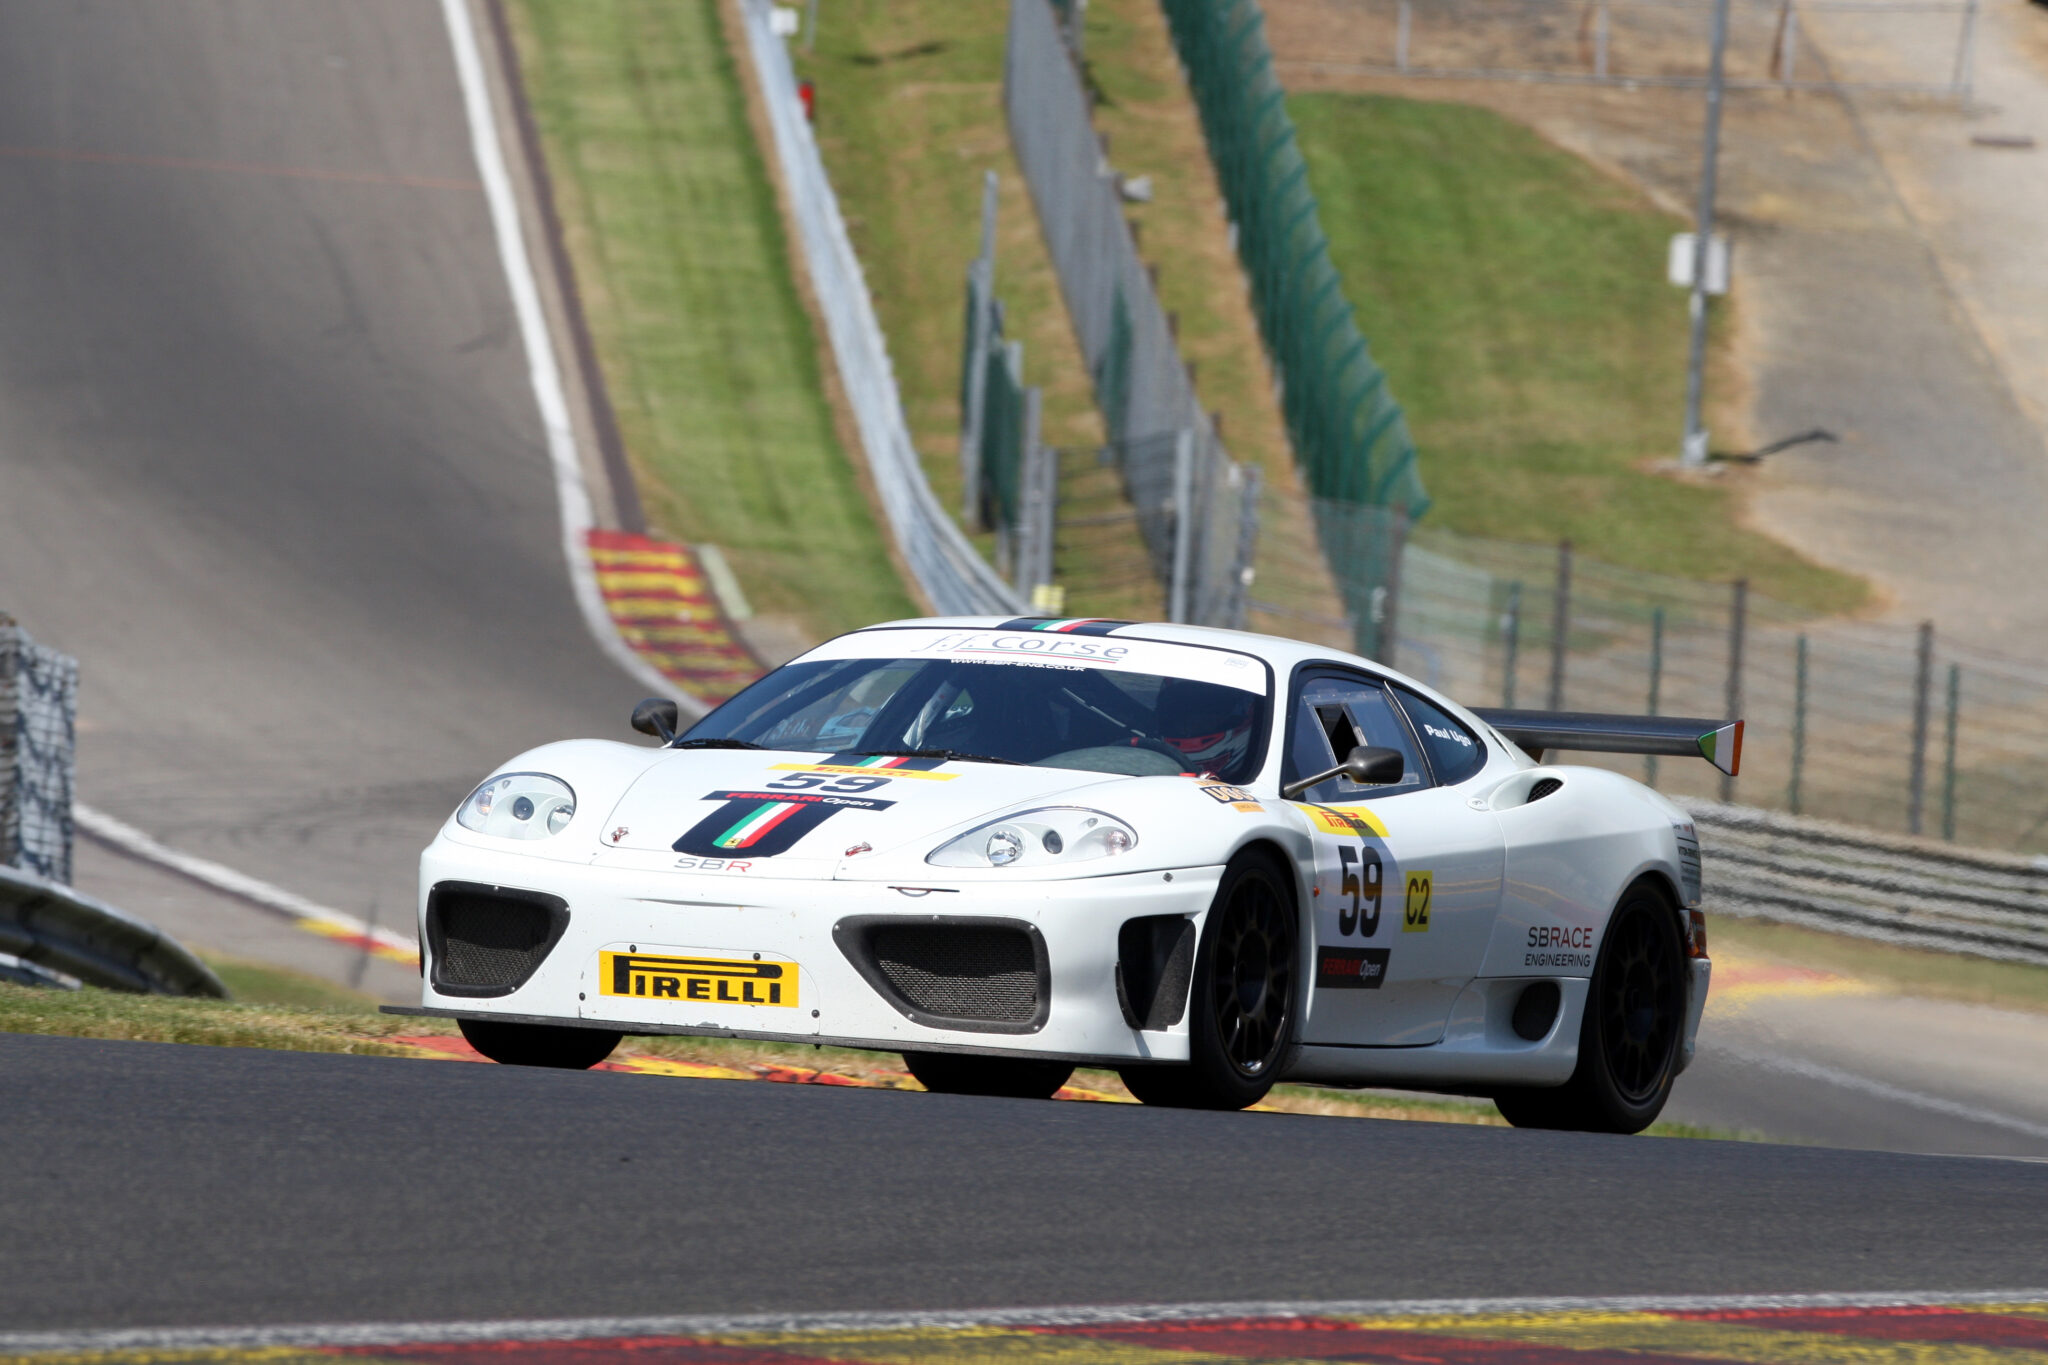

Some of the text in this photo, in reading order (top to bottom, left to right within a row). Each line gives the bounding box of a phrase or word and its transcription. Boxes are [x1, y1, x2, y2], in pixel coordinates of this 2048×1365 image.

[1424, 724, 1472, 747] Paul Ugo
[765, 772, 893, 793] 59
[1319, 811, 1368, 829] PIRELLI
[674, 858, 752, 872] SBR
[1338, 845, 1383, 938] 59
[1406, 878, 1430, 925] C2
[1527, 927, 1593, 948] SBRACE
[1524, 953, 1591, 967] ENGINEERING
[613, 955, 783, 1004] PIRELLI
